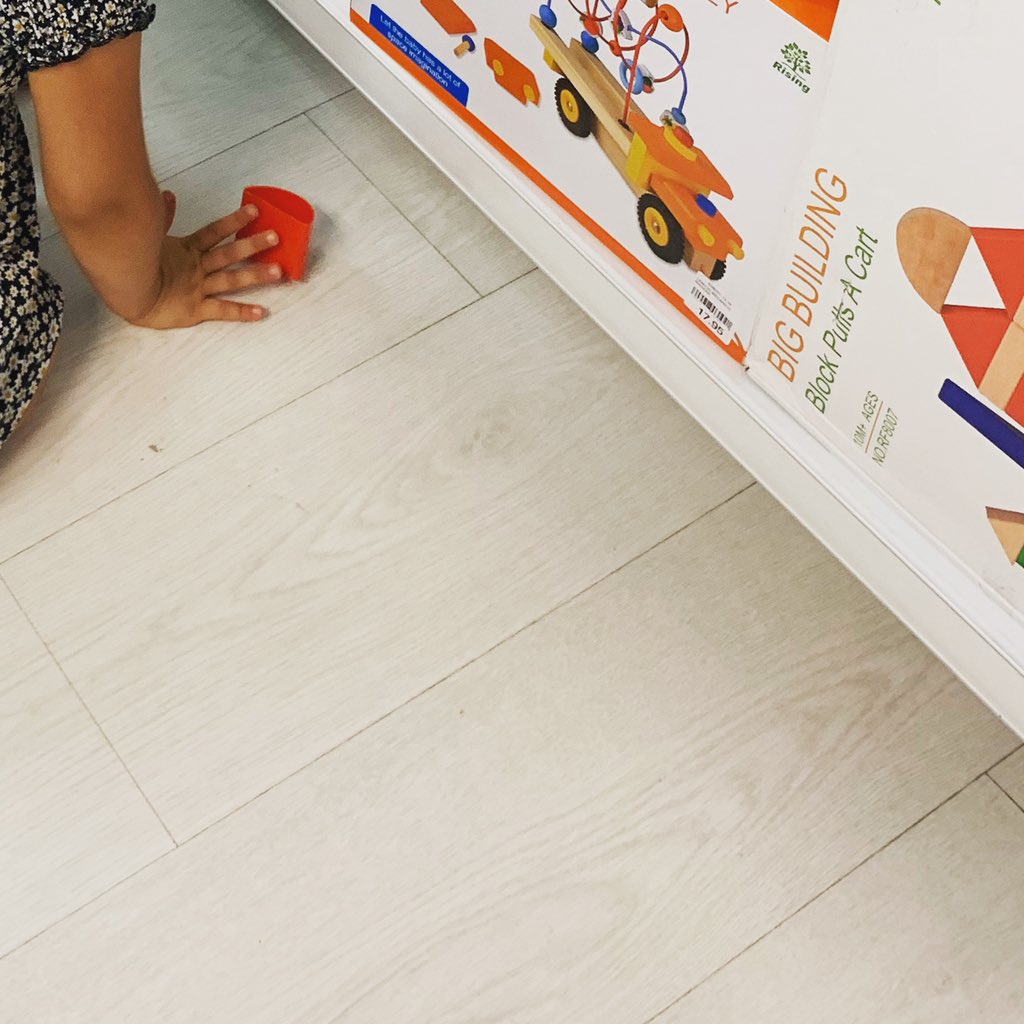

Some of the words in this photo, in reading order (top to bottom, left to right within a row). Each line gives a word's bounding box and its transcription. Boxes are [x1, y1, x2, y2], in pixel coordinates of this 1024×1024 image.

[380, 15, 391, 29] Let
[392, 24, 403, 37] the
[404, 37, 422, 55] baby
[422, 51, 436, 66] has
[436, 65, 442, 73] a
[442, 68, 452, 81] lot
[452, 80, 462, 88] of
[387, 32, 408, 53] space
[408, 50, 449, 87] imagination
[772, 61, 811, 94] Rising
[781, 167, 848, 327] BUILDING
[845, 225, 879, 280] Cart
[840, 279, 862, 305] A
[698, 307, 724, 336] 17.95
[766, 321, 805, 383] BIG
[805, 352, 839, 414] Block
[853, 423, 866, 447] 10M+
[861, 390, 879, 423] AGES
[876, 407, 898, 450] RF8007
[871, 446, 886, 467] NO
